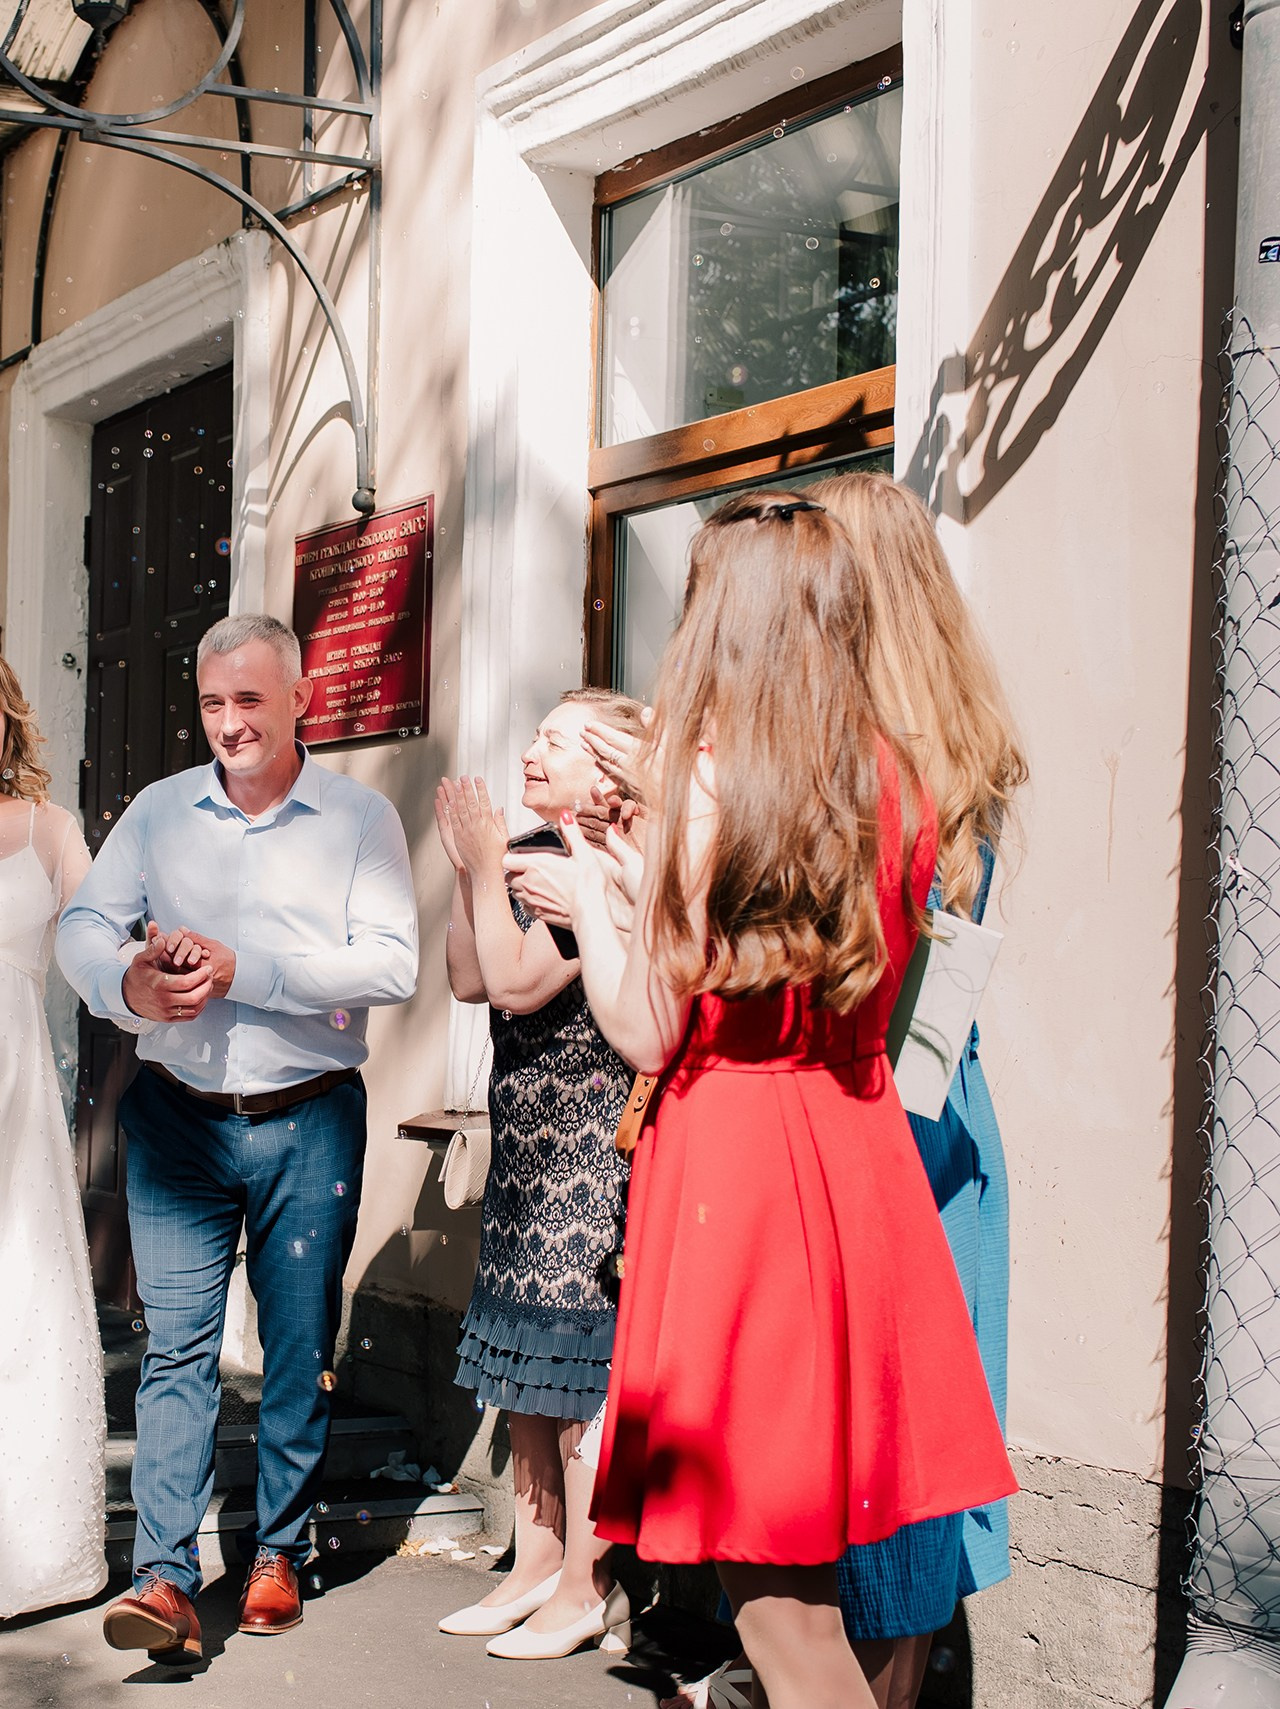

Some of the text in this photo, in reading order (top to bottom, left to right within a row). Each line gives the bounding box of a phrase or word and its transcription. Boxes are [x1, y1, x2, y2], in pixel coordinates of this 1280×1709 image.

[319, 539, 356, 560] ГРАЖДАН
[356, 527, 397, 548] СЕКТОРОМ
[398, 516, 426, 536] ЗАГС
[309, 542, 408, 581] КРОНШТАДТСКОГО РАЙОНА
[350, 642, 382, 657] ГРАЖДАН
[383, 651, 403, 664] ЗАГС
